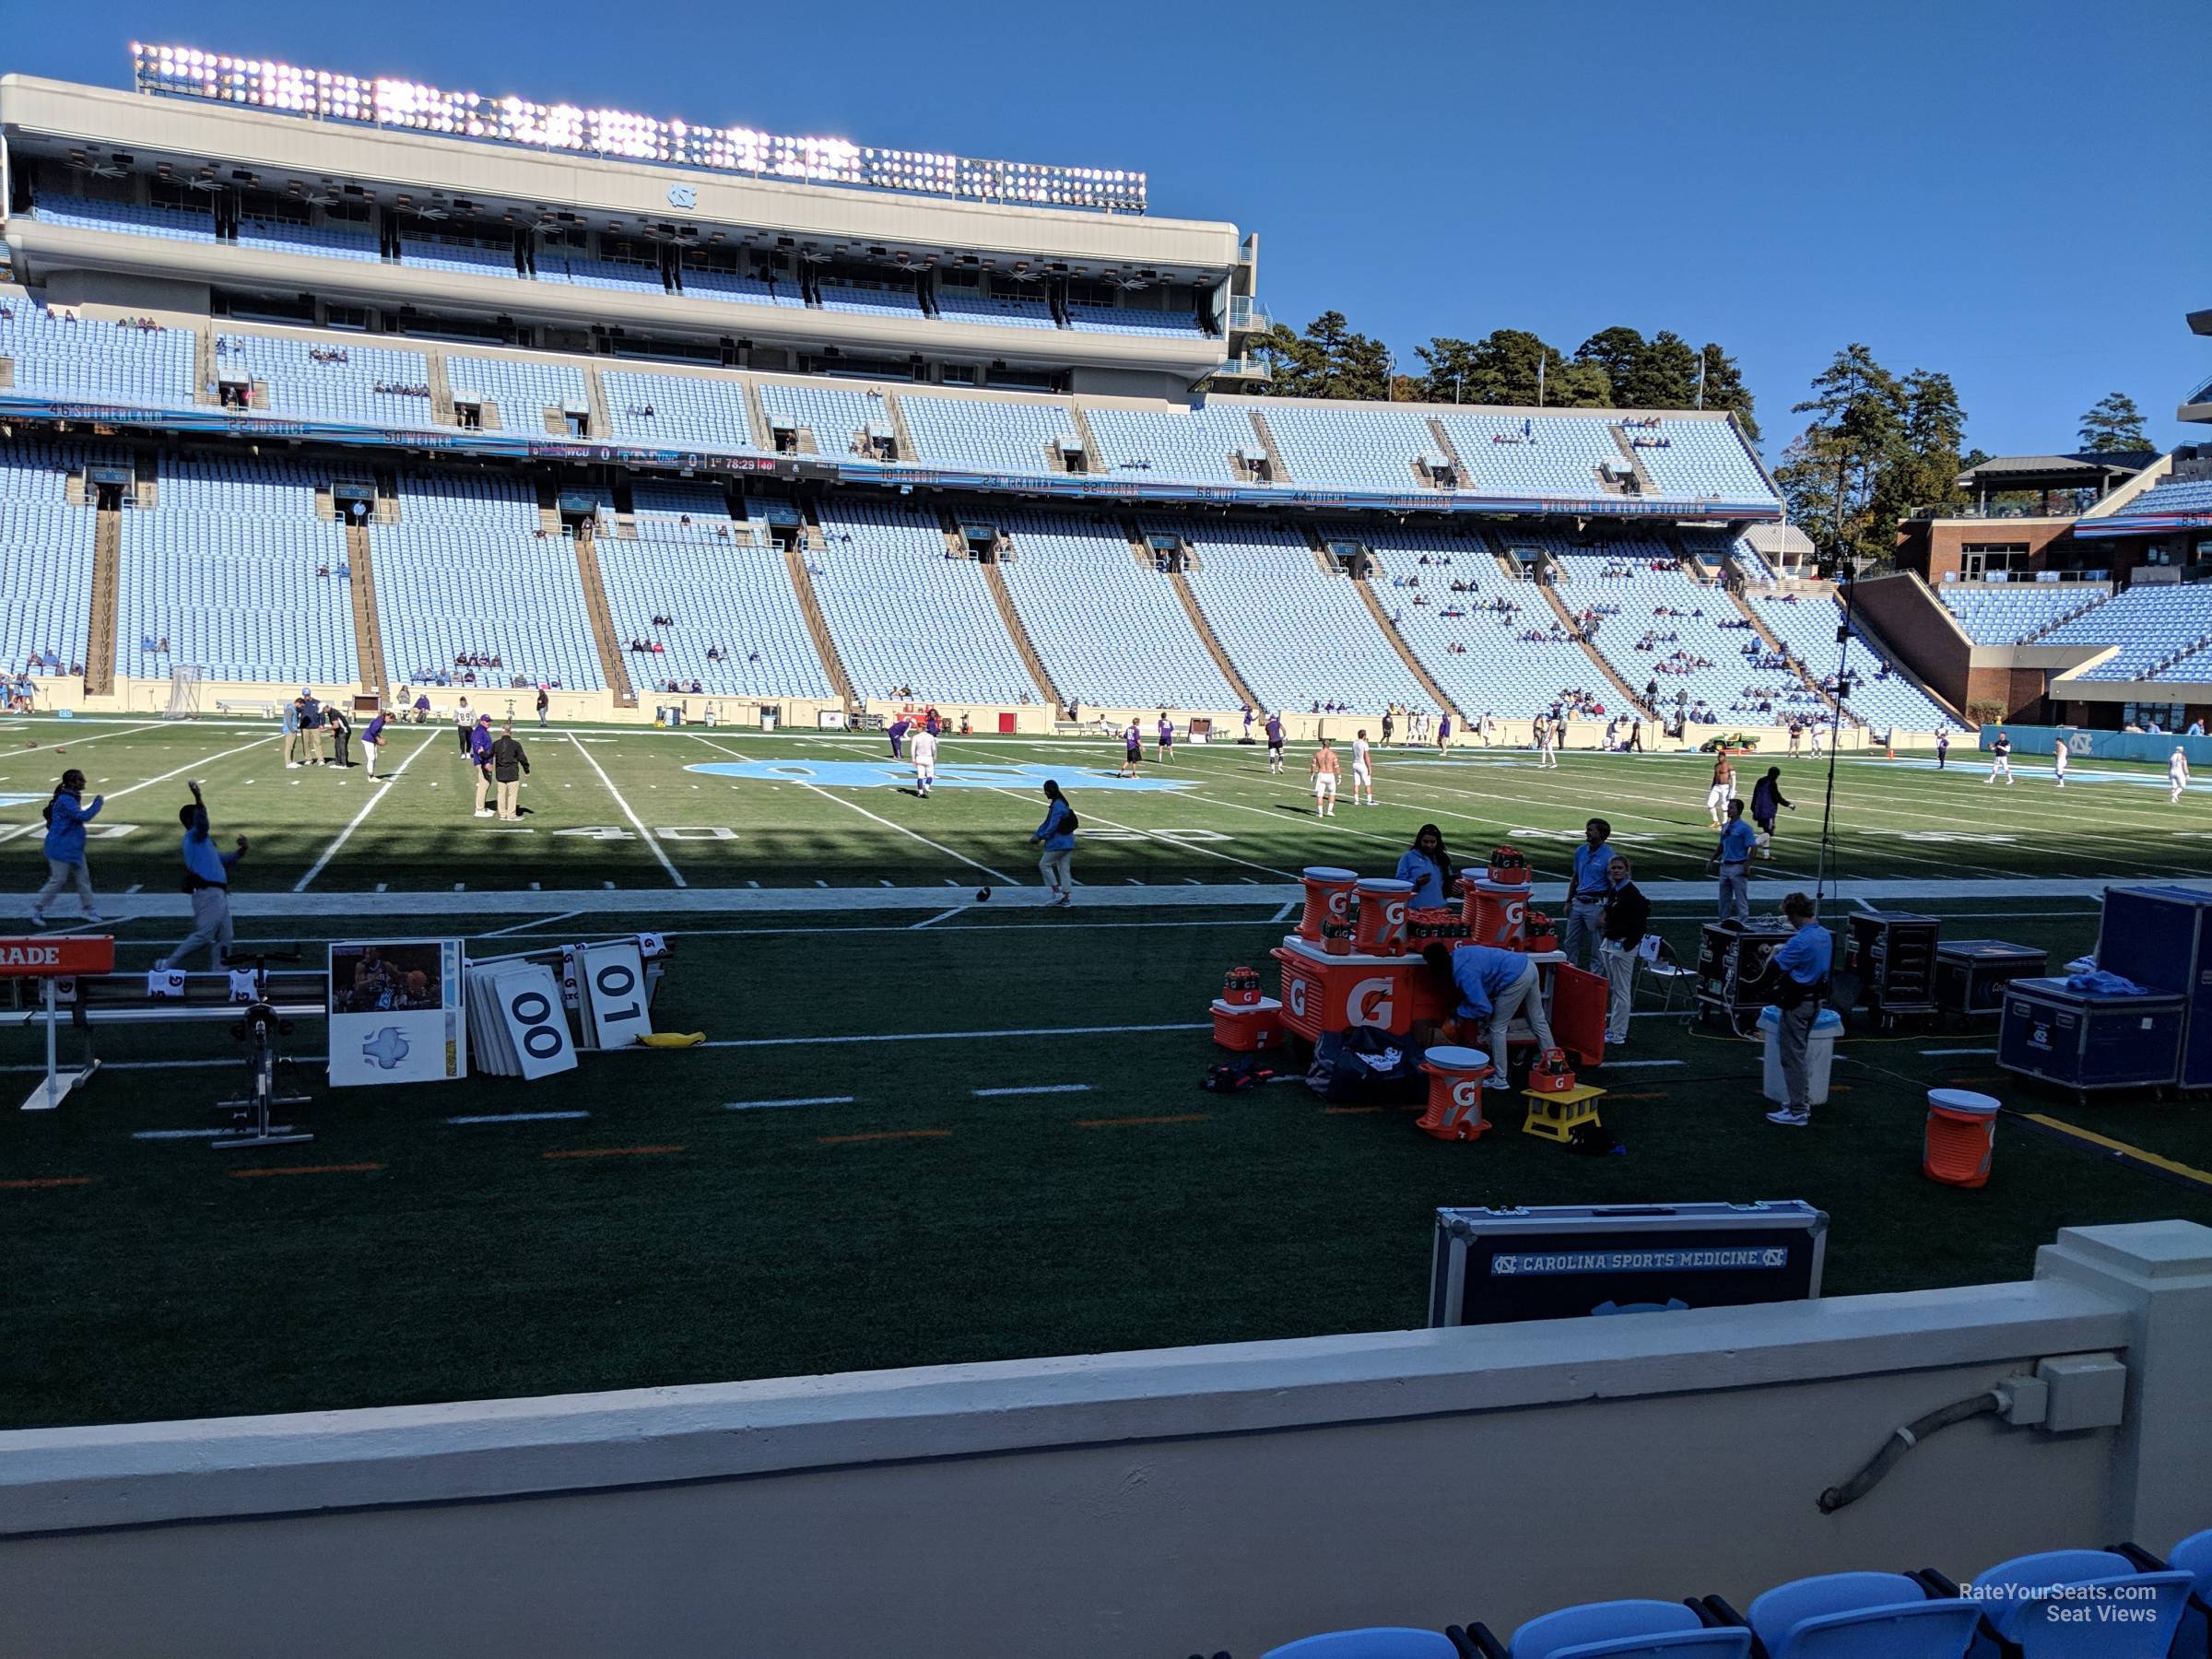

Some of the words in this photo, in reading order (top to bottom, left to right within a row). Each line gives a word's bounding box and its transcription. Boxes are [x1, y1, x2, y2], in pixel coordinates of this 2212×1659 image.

[49, 403, 70, 417] 46
[73, 405, 163, 423] SUTHERLAND
[251, 420, 306, 435] JUSTICE
[384, 430, 402, 443] 50
[567, 446, 590, 457] WCU
[601, 447, 610, 461] 0
[688, 453, 698, 467] 0
[725, 458, 755, 470] 78:29
[1196, 487, 1212, 499] 68
[1541, 500, 1594, 513] WELCOME
[1599, 501, 1611, 513] TO
[1616, 501, 1652, 514] KENAN
[1656, 502, 1706, 514] STADIUM
[459, 712, 471, 722] 89
[1328, 891, 1347, 914] G
[1385, 901, 1405, 925] G
[1505, 901, 1525, 924] G
[1243, 992, 1253, 1002] G
[1289, 978, 1306, 1017] G
[1347, 976, 1394, 1030] G
[1555, 1077, 1564, 1088] G
[1453, 1080, 1476, 1107] G
[1523, 1254, 1606, 1272] CAROLINA
[1611, 1252, 1676, 1270] SPORTS
[1680, 1250, 1759, 1268] MEDICINE
